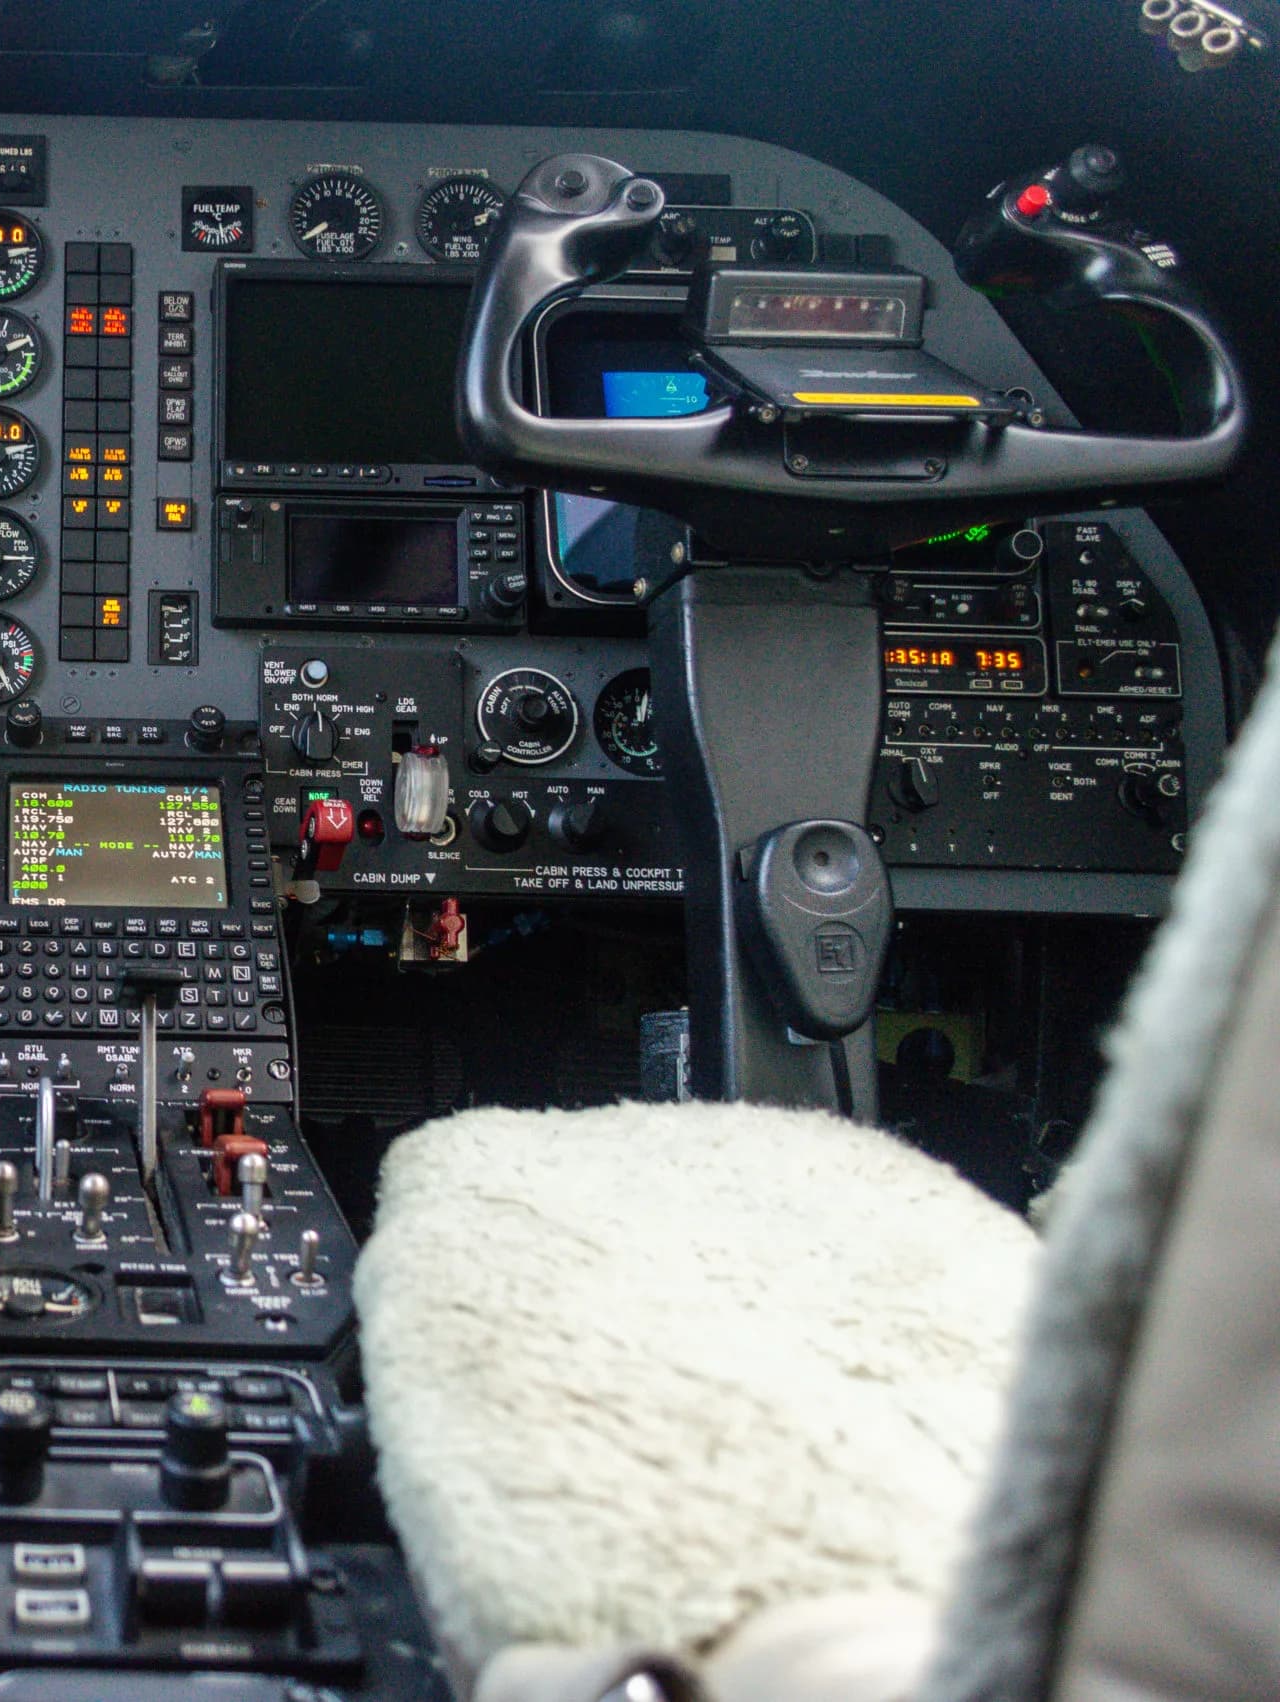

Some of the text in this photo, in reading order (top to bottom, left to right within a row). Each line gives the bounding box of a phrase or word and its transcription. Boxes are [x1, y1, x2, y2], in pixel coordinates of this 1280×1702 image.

[19, 148, 32, 156] LBS
[193, 204, 240, 213] FUEL TEMP
[164, 296, 189, 305] BELOW
[3, 640, 16, 648] PSI
[976, 652, 1021, 668] 7:35
[264, 661, 285, 669] VENT
[264, 669, 297, 677] BLOWER
[264, 676, 295, 684] ON/OFF
[292, 694, 338, 702] BOTH NORM
[486, 686, 502, 714] CABIN
[283, 704, 300, 712] ENG
[396, 705, 417, 713] GEAR
[269, 725, 285, 733] OFF
[354, 728, 371, 736] ENG
[437, 736, 448, 744] UP
[519, 740, 540, 748] CABIN
[507, 745, 552, 756] CONTROLLER
[995, 743, 1050, 752] AUDIO OFF
[342, 761, 363, 769] EMER
[980, 762, 1000, 770] SPKR
[1049, 762, 1072, 771] VOICE
[289, 769, 341, 778] CABIN PRESS
[360, 779, 383, 787] DOWN
[1074, 778, 1096, 786] BOTH
[63, 784, 106, 793] RADIO
[115, 785, 166, 794] TUNING
[361, 786, 382, 794] LOCK
[548, 786, 569, 794] AUTO
[587, 786, 604, 795] MAN
[363, 794, 379, 802] REL
[469, 790, 490, 798] COLD
[512, 791, 528, 799] HOT
[1050, 792, 1073, 801] IDENT
[14, 800, 73, 808] 118.600
[275, 797, 296, 805] GEAR
[159, 802, 218, 810] 127.550
[273, 805, 296, 813] DOWN
[14, 816, 74, 824] 119.750
[14, 832, 65, 840] 110.70
[22, 840, 47, 848] NAV
[13, 848, 83, 857] AUTO/MAN
[152, 851, 222, 859] AUTO/MAN
[428, 851, 460, 860] SILENCE
[21, 864, 65, 872] 400.0
[536, 866, 668, 879] CABIN PRESS COCKPIT
[22, 873, 48, 881] ATC
[171, 876, 197, 884] ATC
[354, 873, 420, 884] CABIN DUMP
[12, 881, 48, 889] 2000
[514, 879, 618, 890] TAKE OFF & LAND
[24, 1045, 43, 1053] RTU
[97, 1046, 116, 1054] RMT
[233, 1048, 252, 1056] MKR
[18, 1053, 48, 1062] DSABL
[239, 1056, 248, 1064] HI
[110, 1084, 135, 1092] NORM
